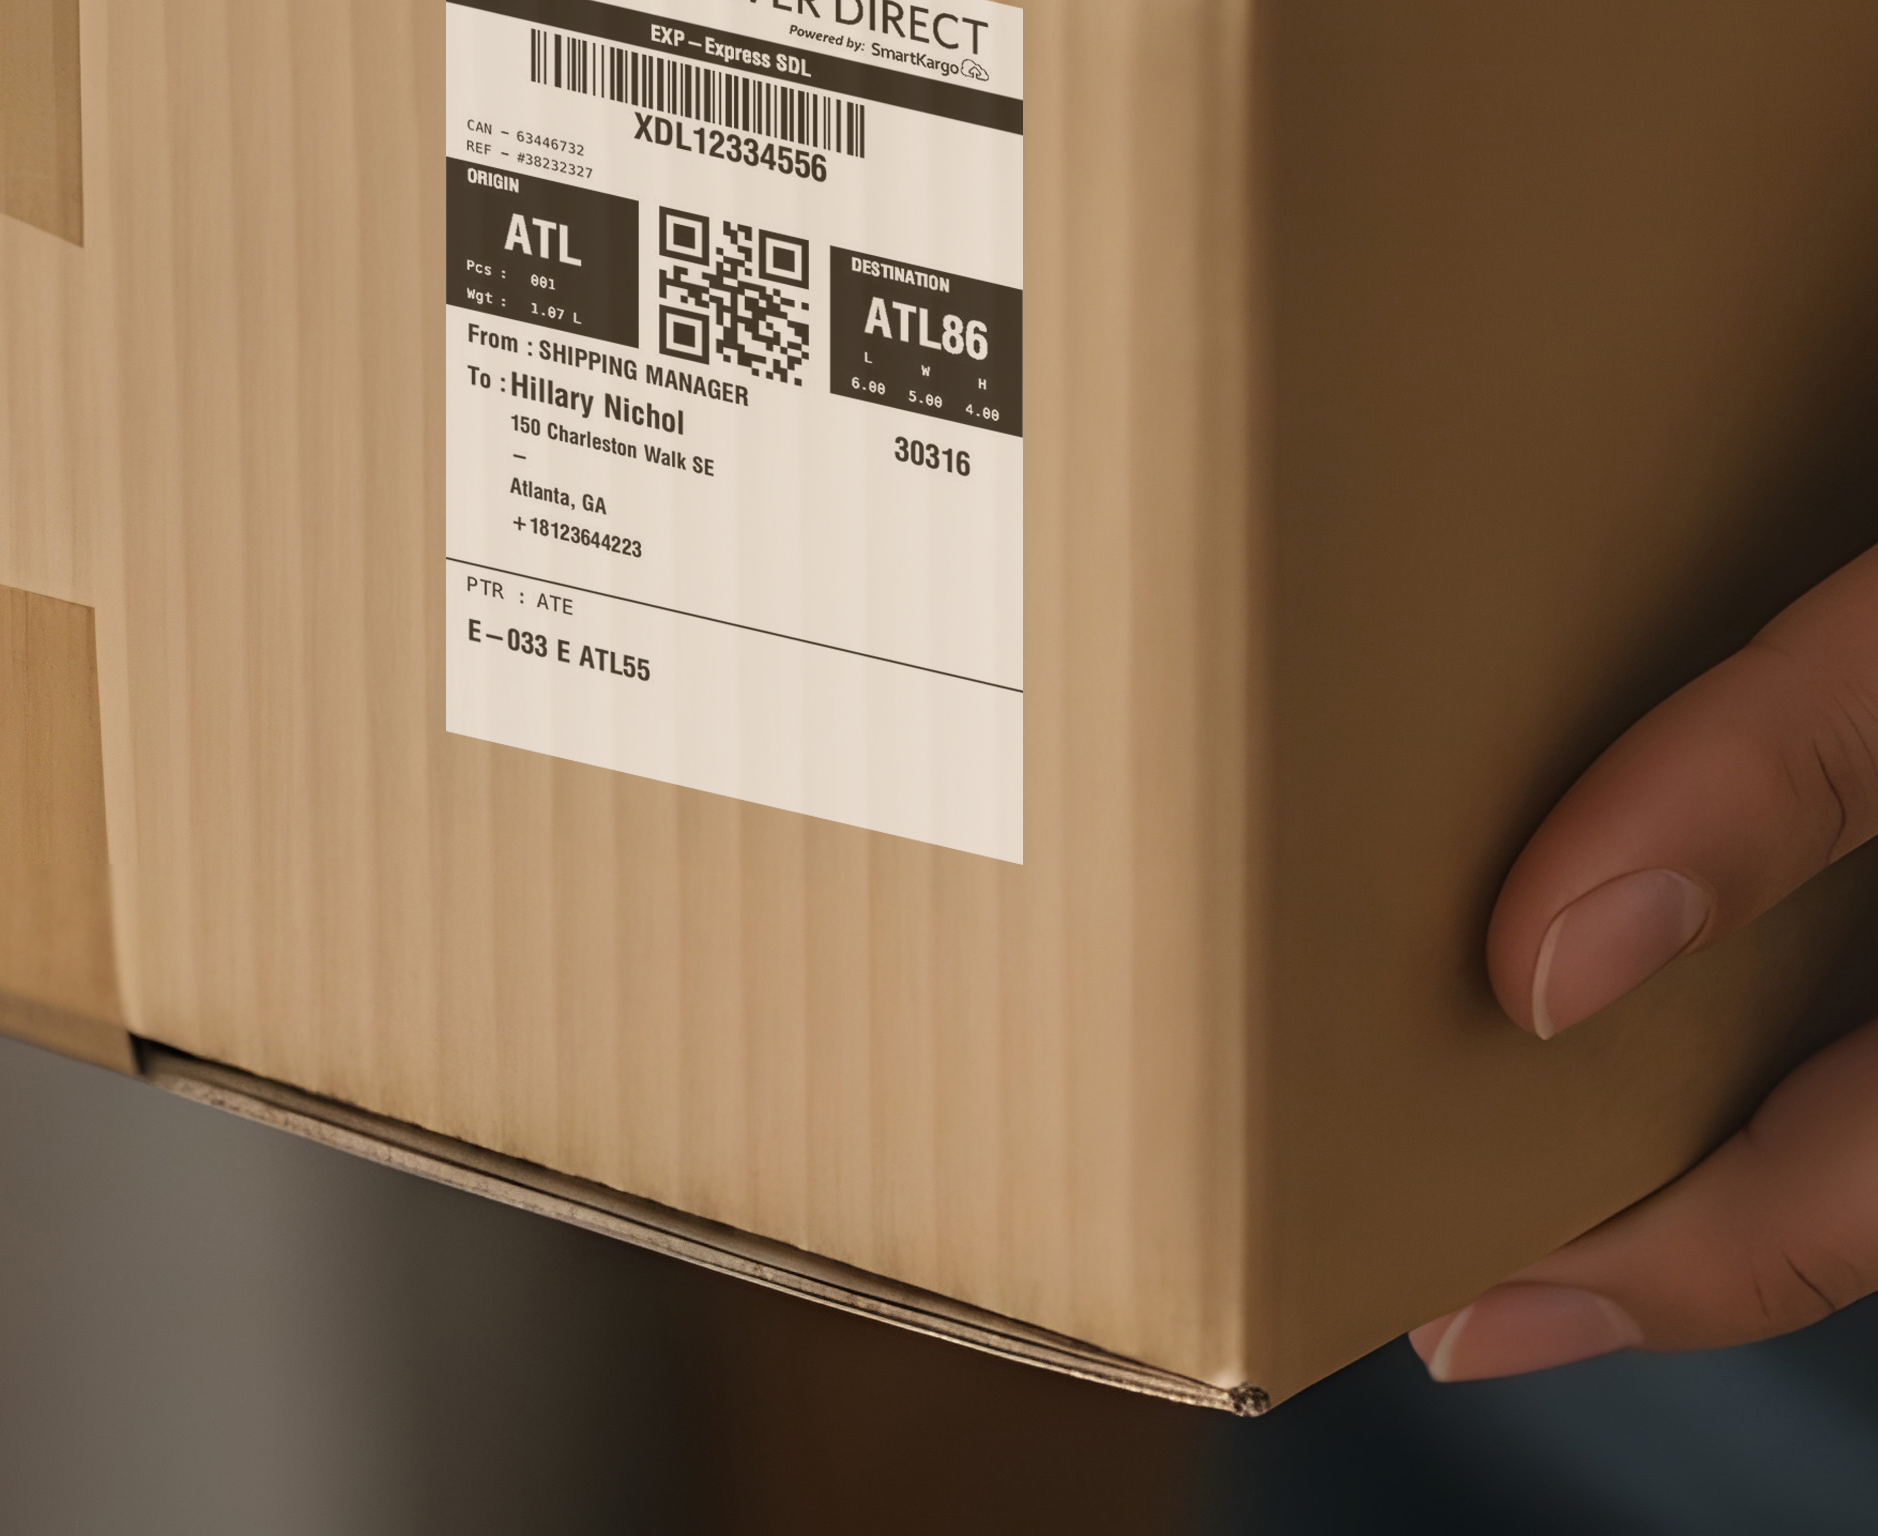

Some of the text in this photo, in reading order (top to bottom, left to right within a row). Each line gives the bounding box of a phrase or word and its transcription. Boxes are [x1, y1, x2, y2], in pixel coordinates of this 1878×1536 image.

[776, 53, 812, 78] SDL
[789, 24, 959, 76] Powered by: SmartKargo
[467, 119, 492, 135] CAN
[516, 130, 584, 157] 63446732
[633, 111, 828, 182] XDL12334556
[466, 139, 491, 155] REF
[517, 152, 593, 179] #38232327
[467, 167, 520, 193] ORIGIN
[504, 213, 582, 267] ATL
[466, 259, 492, 276] Pcs
[530, 273, 556, 290] 001
[851, 256, 950, 293] DESTINATION
[466, 287, 493, 305] Wgt
[531, 302, 565, 320] 1.07
[573, 312, 582, 325] L
[864, 296, 989, 361] ATL86
[468, 322, 518, 353] From
[539, 339, 637, 381] SHIPPING
[646, 364, 749, 407] MANAGER
[864, 351, 987, 390] L W H
[467, 364, 491, 389] To
[511, 371, 594, 419] Hillary
[604, 392, 684, 436] Nichol
[851, 376, 1000, 422] 6.00 5.00 4.00
[510, 414, 714, 477] 150 Charleston Walk SE
[894, 436, 971, 477] 30316
[509, 477, 607, 515] Atlanta, GA
[467, 575, 504, 600] PTR
[536, 592, 573, 616] ATE
[557, 638, 570, 664] E
[579, 645, 651, 682] ATL55
